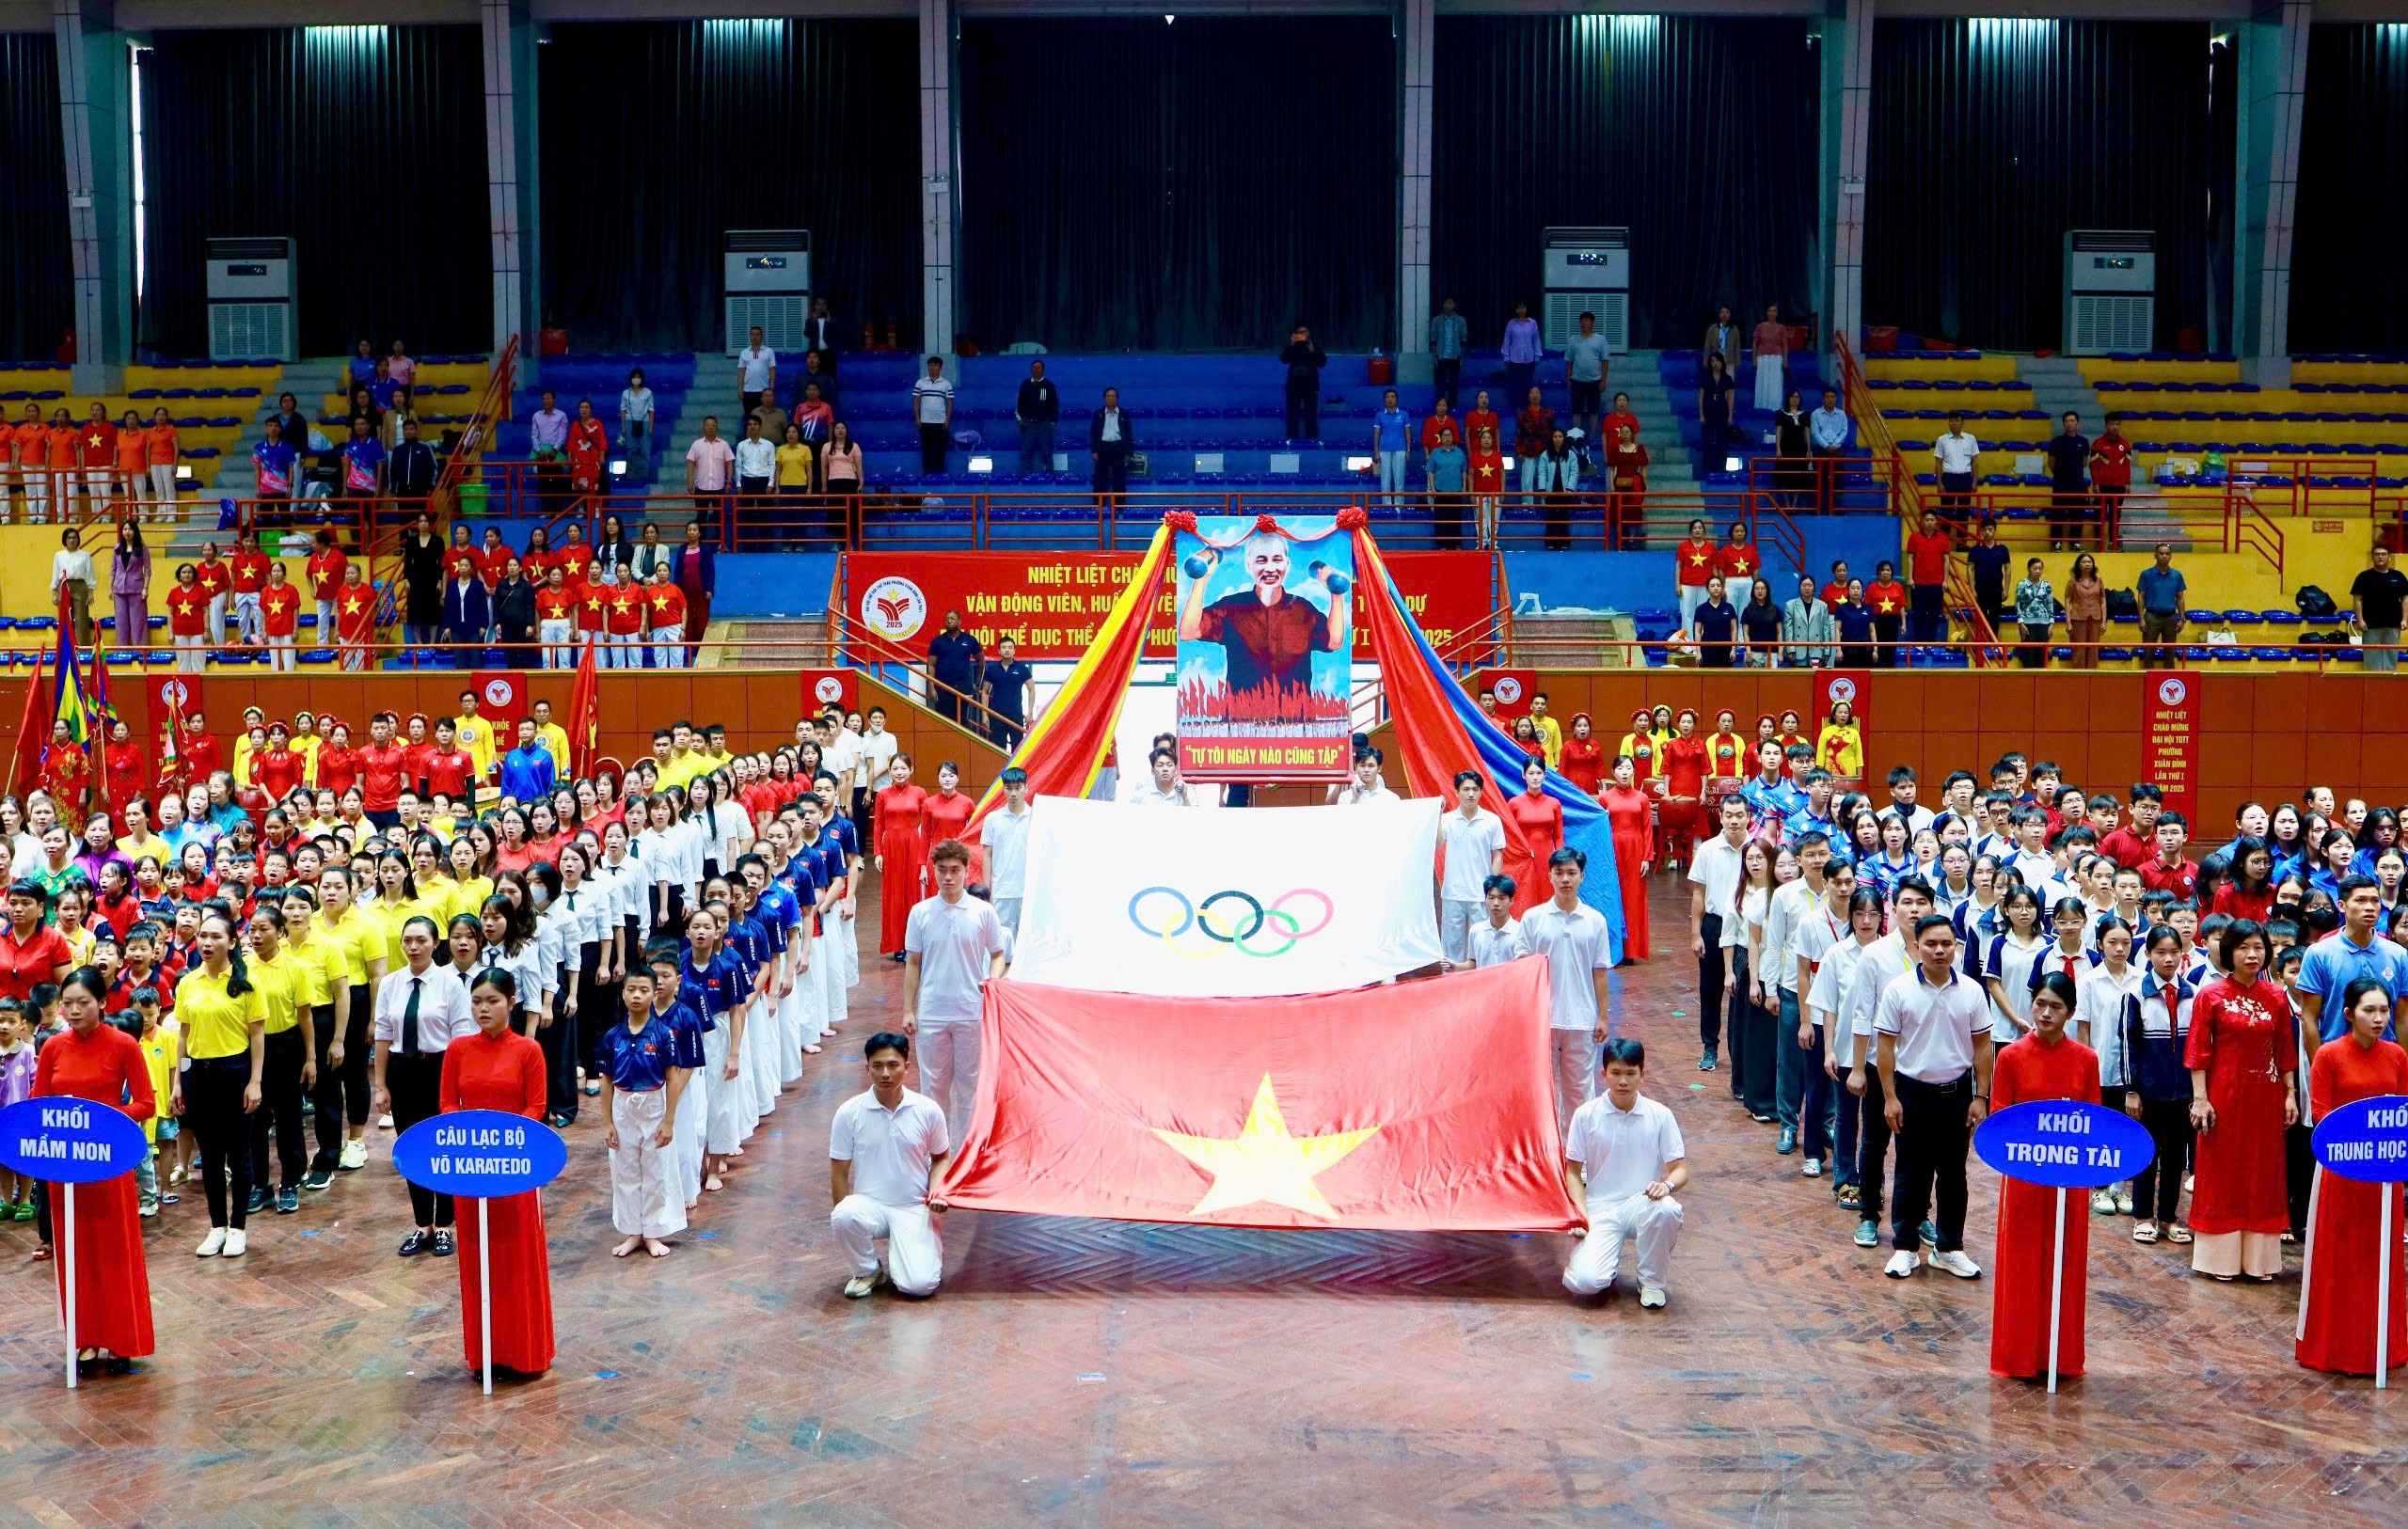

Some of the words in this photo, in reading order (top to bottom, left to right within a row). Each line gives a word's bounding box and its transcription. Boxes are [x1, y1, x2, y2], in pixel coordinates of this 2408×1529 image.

[1028, 563, 1071, 587] NHIỆT
[1076, 563, 1101, 587] LIỆT
[966, 592, 996, 616] VẬN
[1001, 592, 1042, 616] ĐỘNG
[1048, 592, 1086, 615] VIÊN,
[1032, 628, 1061, 649] DỤC
[1066, 622, 1095, 646] THỂ
[1421, 629, 1452, 646] 025
[2176, 735, 2190, 744] TDTT
[1208, 746, 1224, 764] TÔI
[1228, 746, 1257, 764] NGÀY
[1259, 746, 1282, 764] NÀO
[1285, 746, 1315, 764] CŨNG
[2157, 783, 2168, 792] ĂM
[42, 1104, 90, 1129] KHỐI
[2037, 1109, 2091, 1134] KHỐI
[2368, 1102, 2408, 1128] KHỐ
[20, 1133, 67, 1159] MẦM
[72, 1141, 111, 1162] NON
[436, 1126, 467, 1146] CÂU
[471, 1128, 500, 1150] LẠC
[504, 1126, 525, 1150] BỘ
[2005, 1142, 2079, 1167] TRỌNG
[2085, 1144, 2121, 1168] TÀI
[2326, 1141, 2374, 1162] TRUNG
[2377, 1140, 2407, 1163] HỌC
[431, 1155, 451, 1174] VÕ
[455, 1158, 531, 1174] KARATEDO
